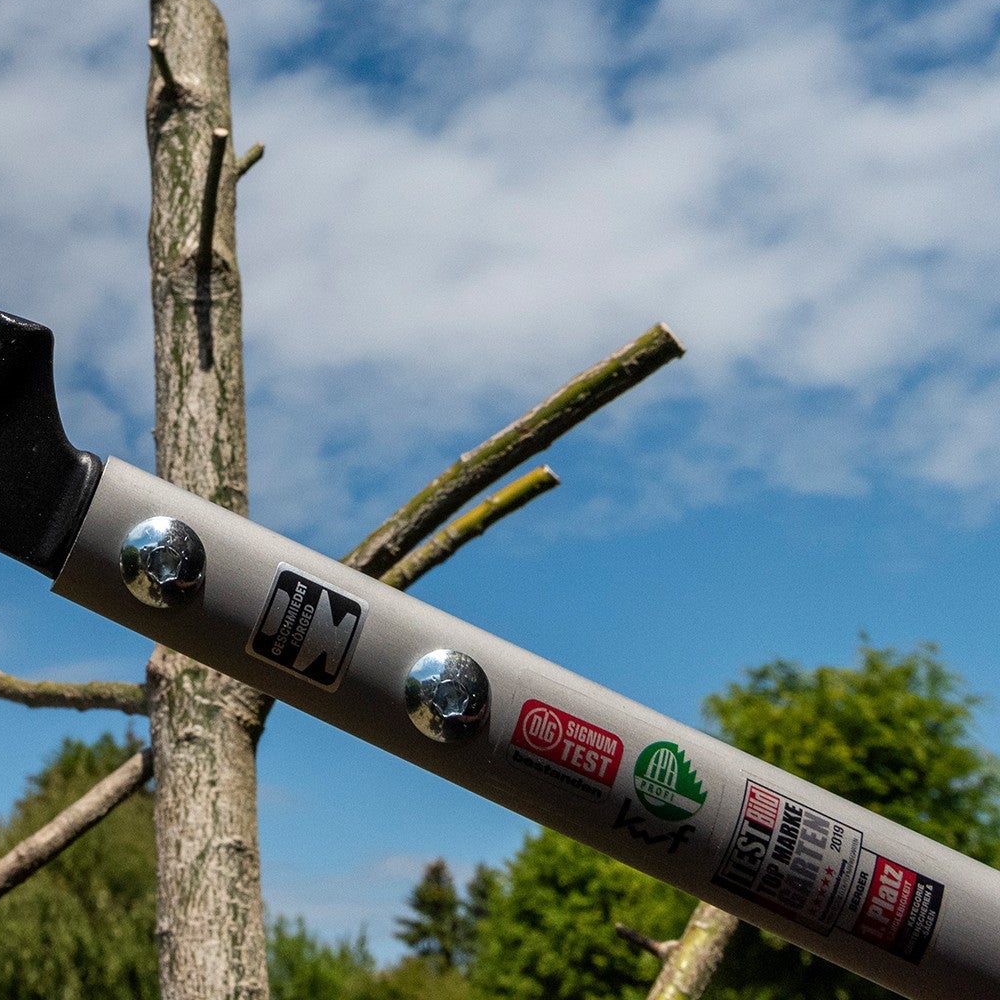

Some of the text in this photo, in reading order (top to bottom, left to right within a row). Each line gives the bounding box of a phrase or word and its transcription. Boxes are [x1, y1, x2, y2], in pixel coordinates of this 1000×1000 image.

[271, 581, 308, 656] GESCHMIEDET
[290, 603, 315, 648] FORGED
[527, 708, 558, 744] DLG
[565, 719, 619, 757] SIGNUM
[512, 748, 604, 799] bestanden
[558, 738, 614, 778] TEST
[639, 779, 676, 803] PROFI
[757, 801, 803, 898] TOP MARKE
[779, 810, 831, 910] GARTEN
[829, 824, 845, 853] 2019
[848, 870, 869, 914] BERGER
[906, 881, 926, 928] KATEGORIE
